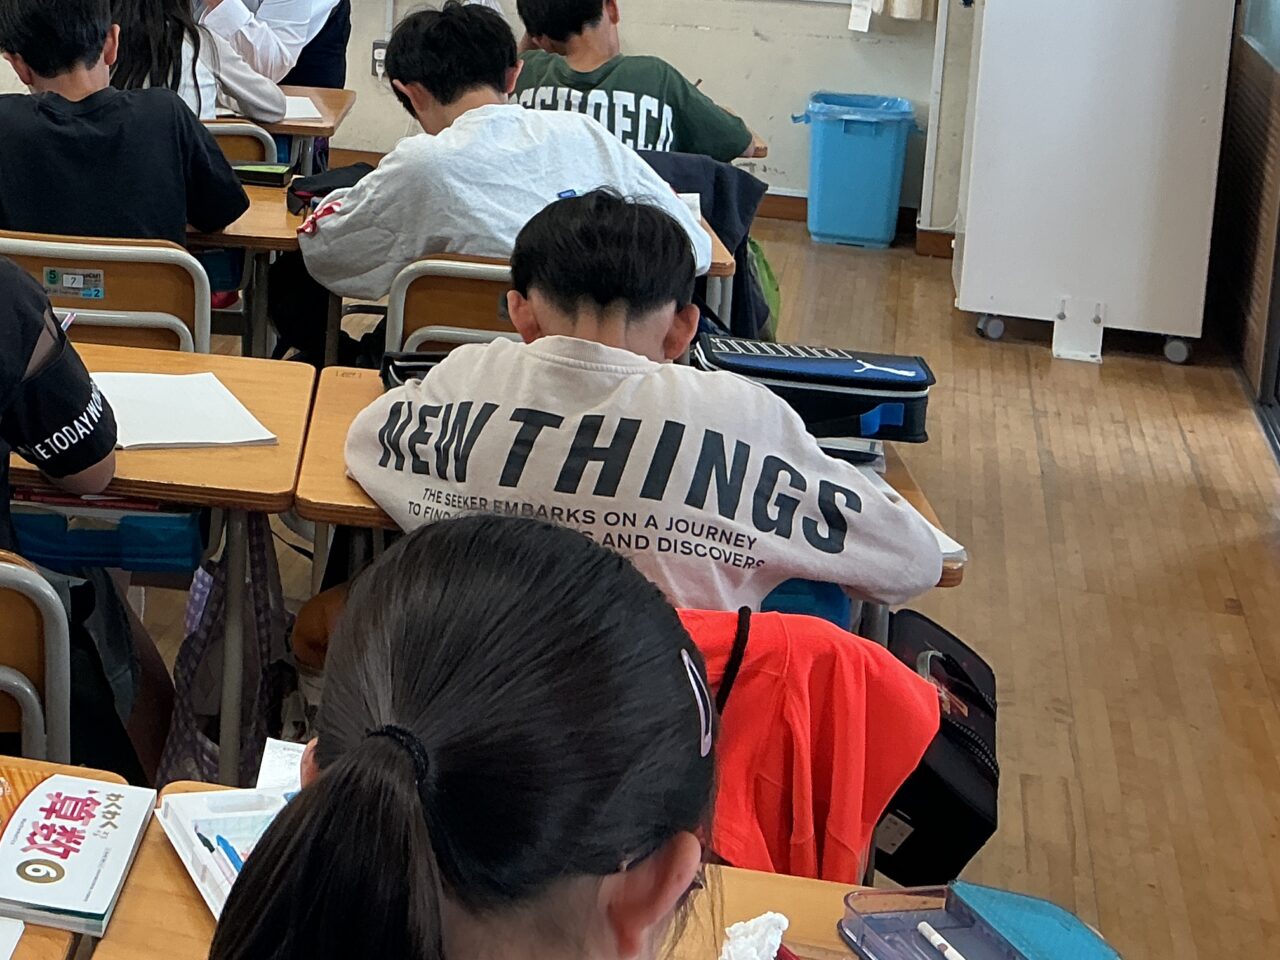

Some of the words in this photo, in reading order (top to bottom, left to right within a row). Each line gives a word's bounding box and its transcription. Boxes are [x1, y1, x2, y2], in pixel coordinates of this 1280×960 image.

[378, 401, 498, 483] NEW
[498, 408, 863, 555] THINGS
[408, 501, 421, 516] TO
[602, 533, 649, 550] AND
[423, 487, 442, 504] THE
[445, 493, 488, 512] SEEKER
[493, 499, 596, 525] EMBARKS
[603, 511, 638, 528] ON
[643, 514, 659, 529] A
[664, 516, 758, 551] JOURNEY
[20, 791, 102, 860] 算数
[25, 864, 57, 879] 6
